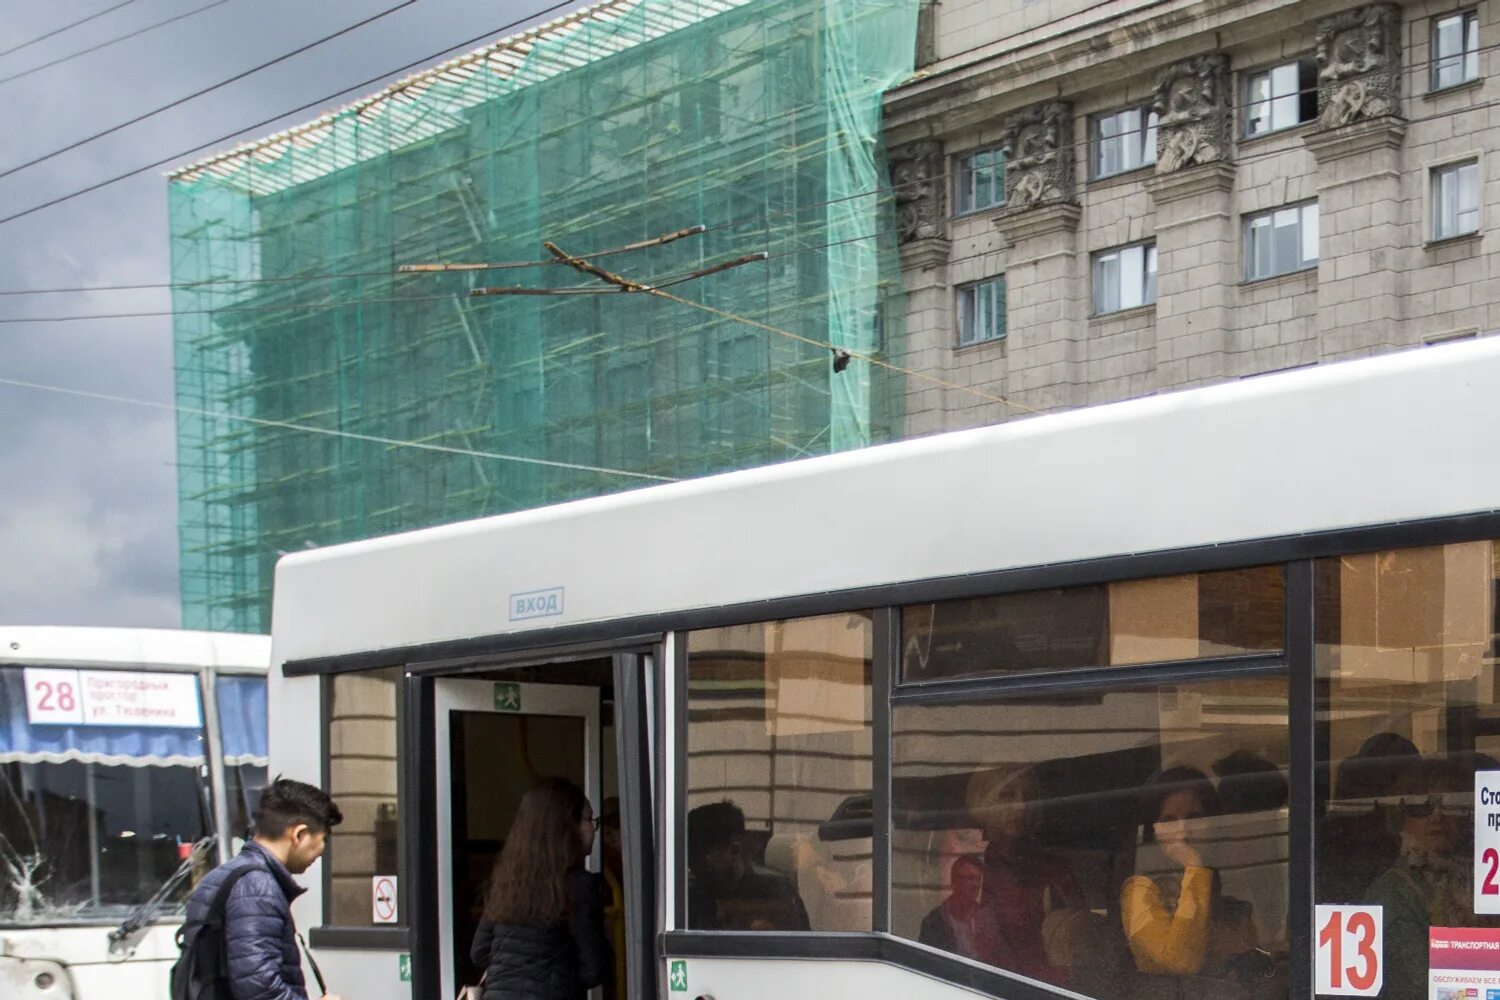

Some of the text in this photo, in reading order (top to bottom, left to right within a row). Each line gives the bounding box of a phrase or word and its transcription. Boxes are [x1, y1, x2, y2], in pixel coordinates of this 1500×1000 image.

[516, 594, 557, 613] ВХОД
[35, 681, 75, 711] 28
[1319, 911, 1378, 990] 13
[1451, 941, 1500, 951] ТРАНСПОРТНАЯ
